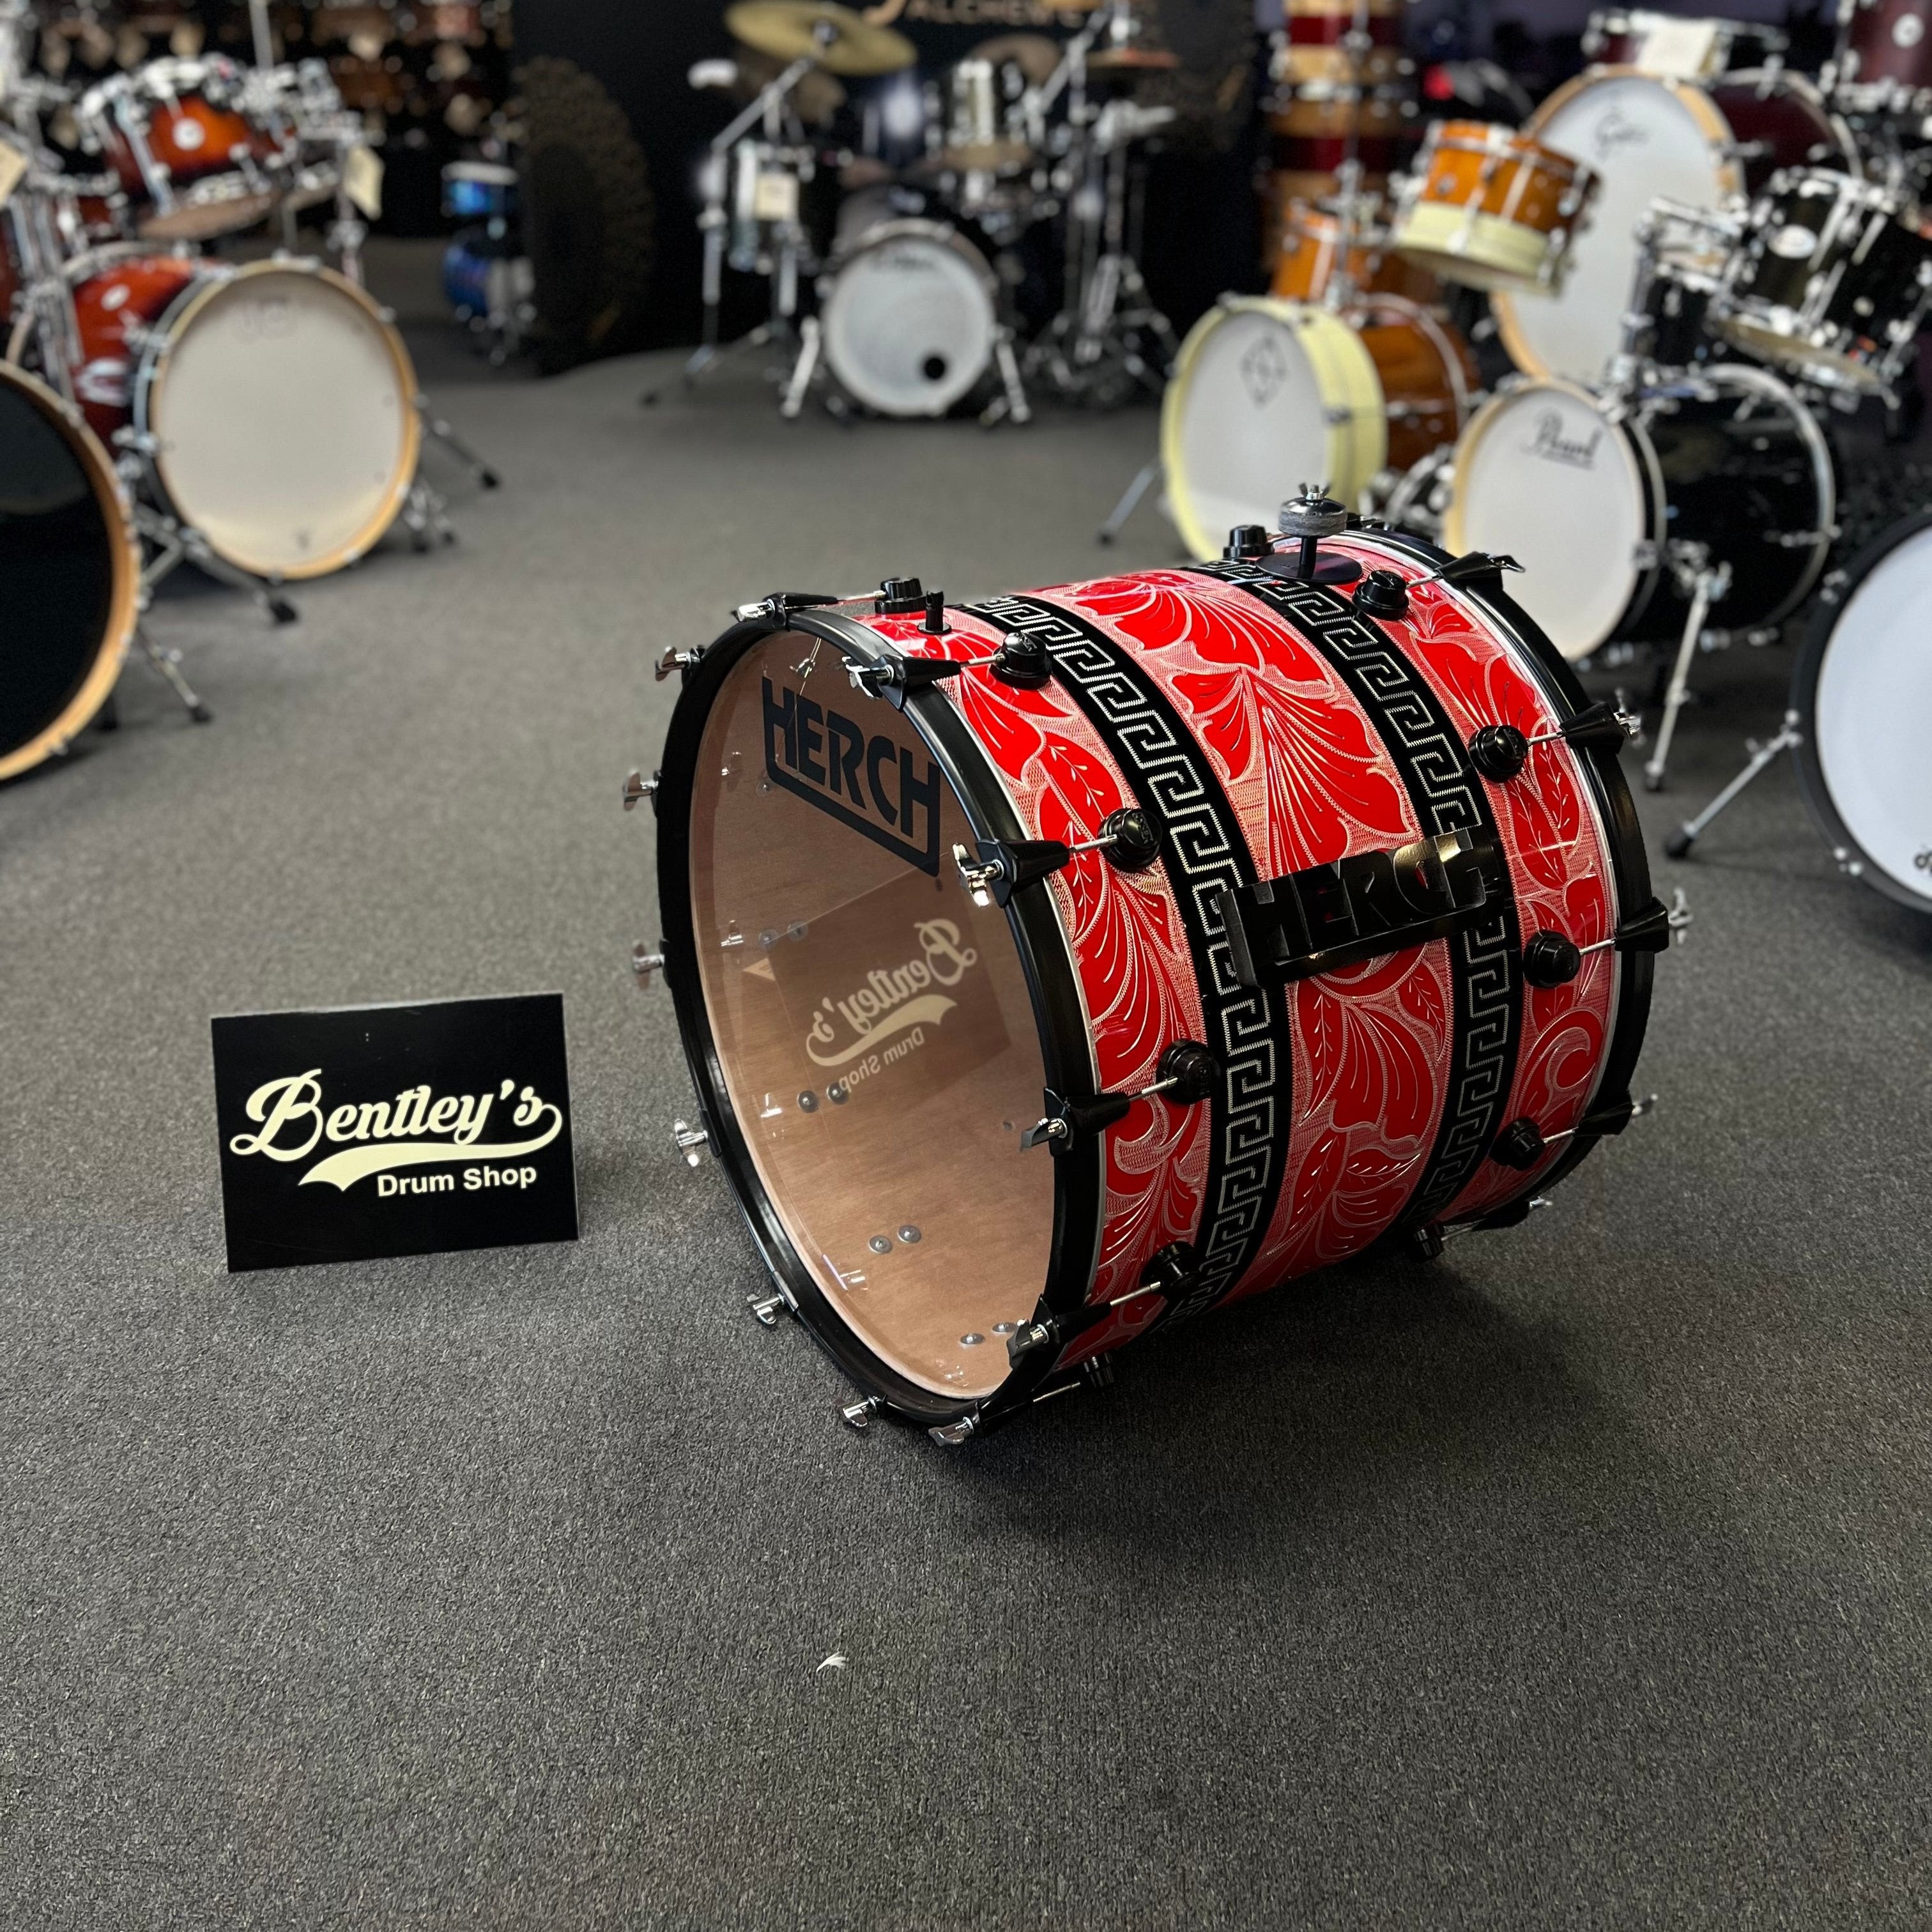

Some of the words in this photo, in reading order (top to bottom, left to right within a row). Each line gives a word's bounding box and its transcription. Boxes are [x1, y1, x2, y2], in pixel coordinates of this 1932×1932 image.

[763, 676, 940, 877] HERCH
[229, 1068, 562, 1162] Bentley's
[377, 1172, 454, 1197] Drum
[463, 1165, 537, 1191] Shop
